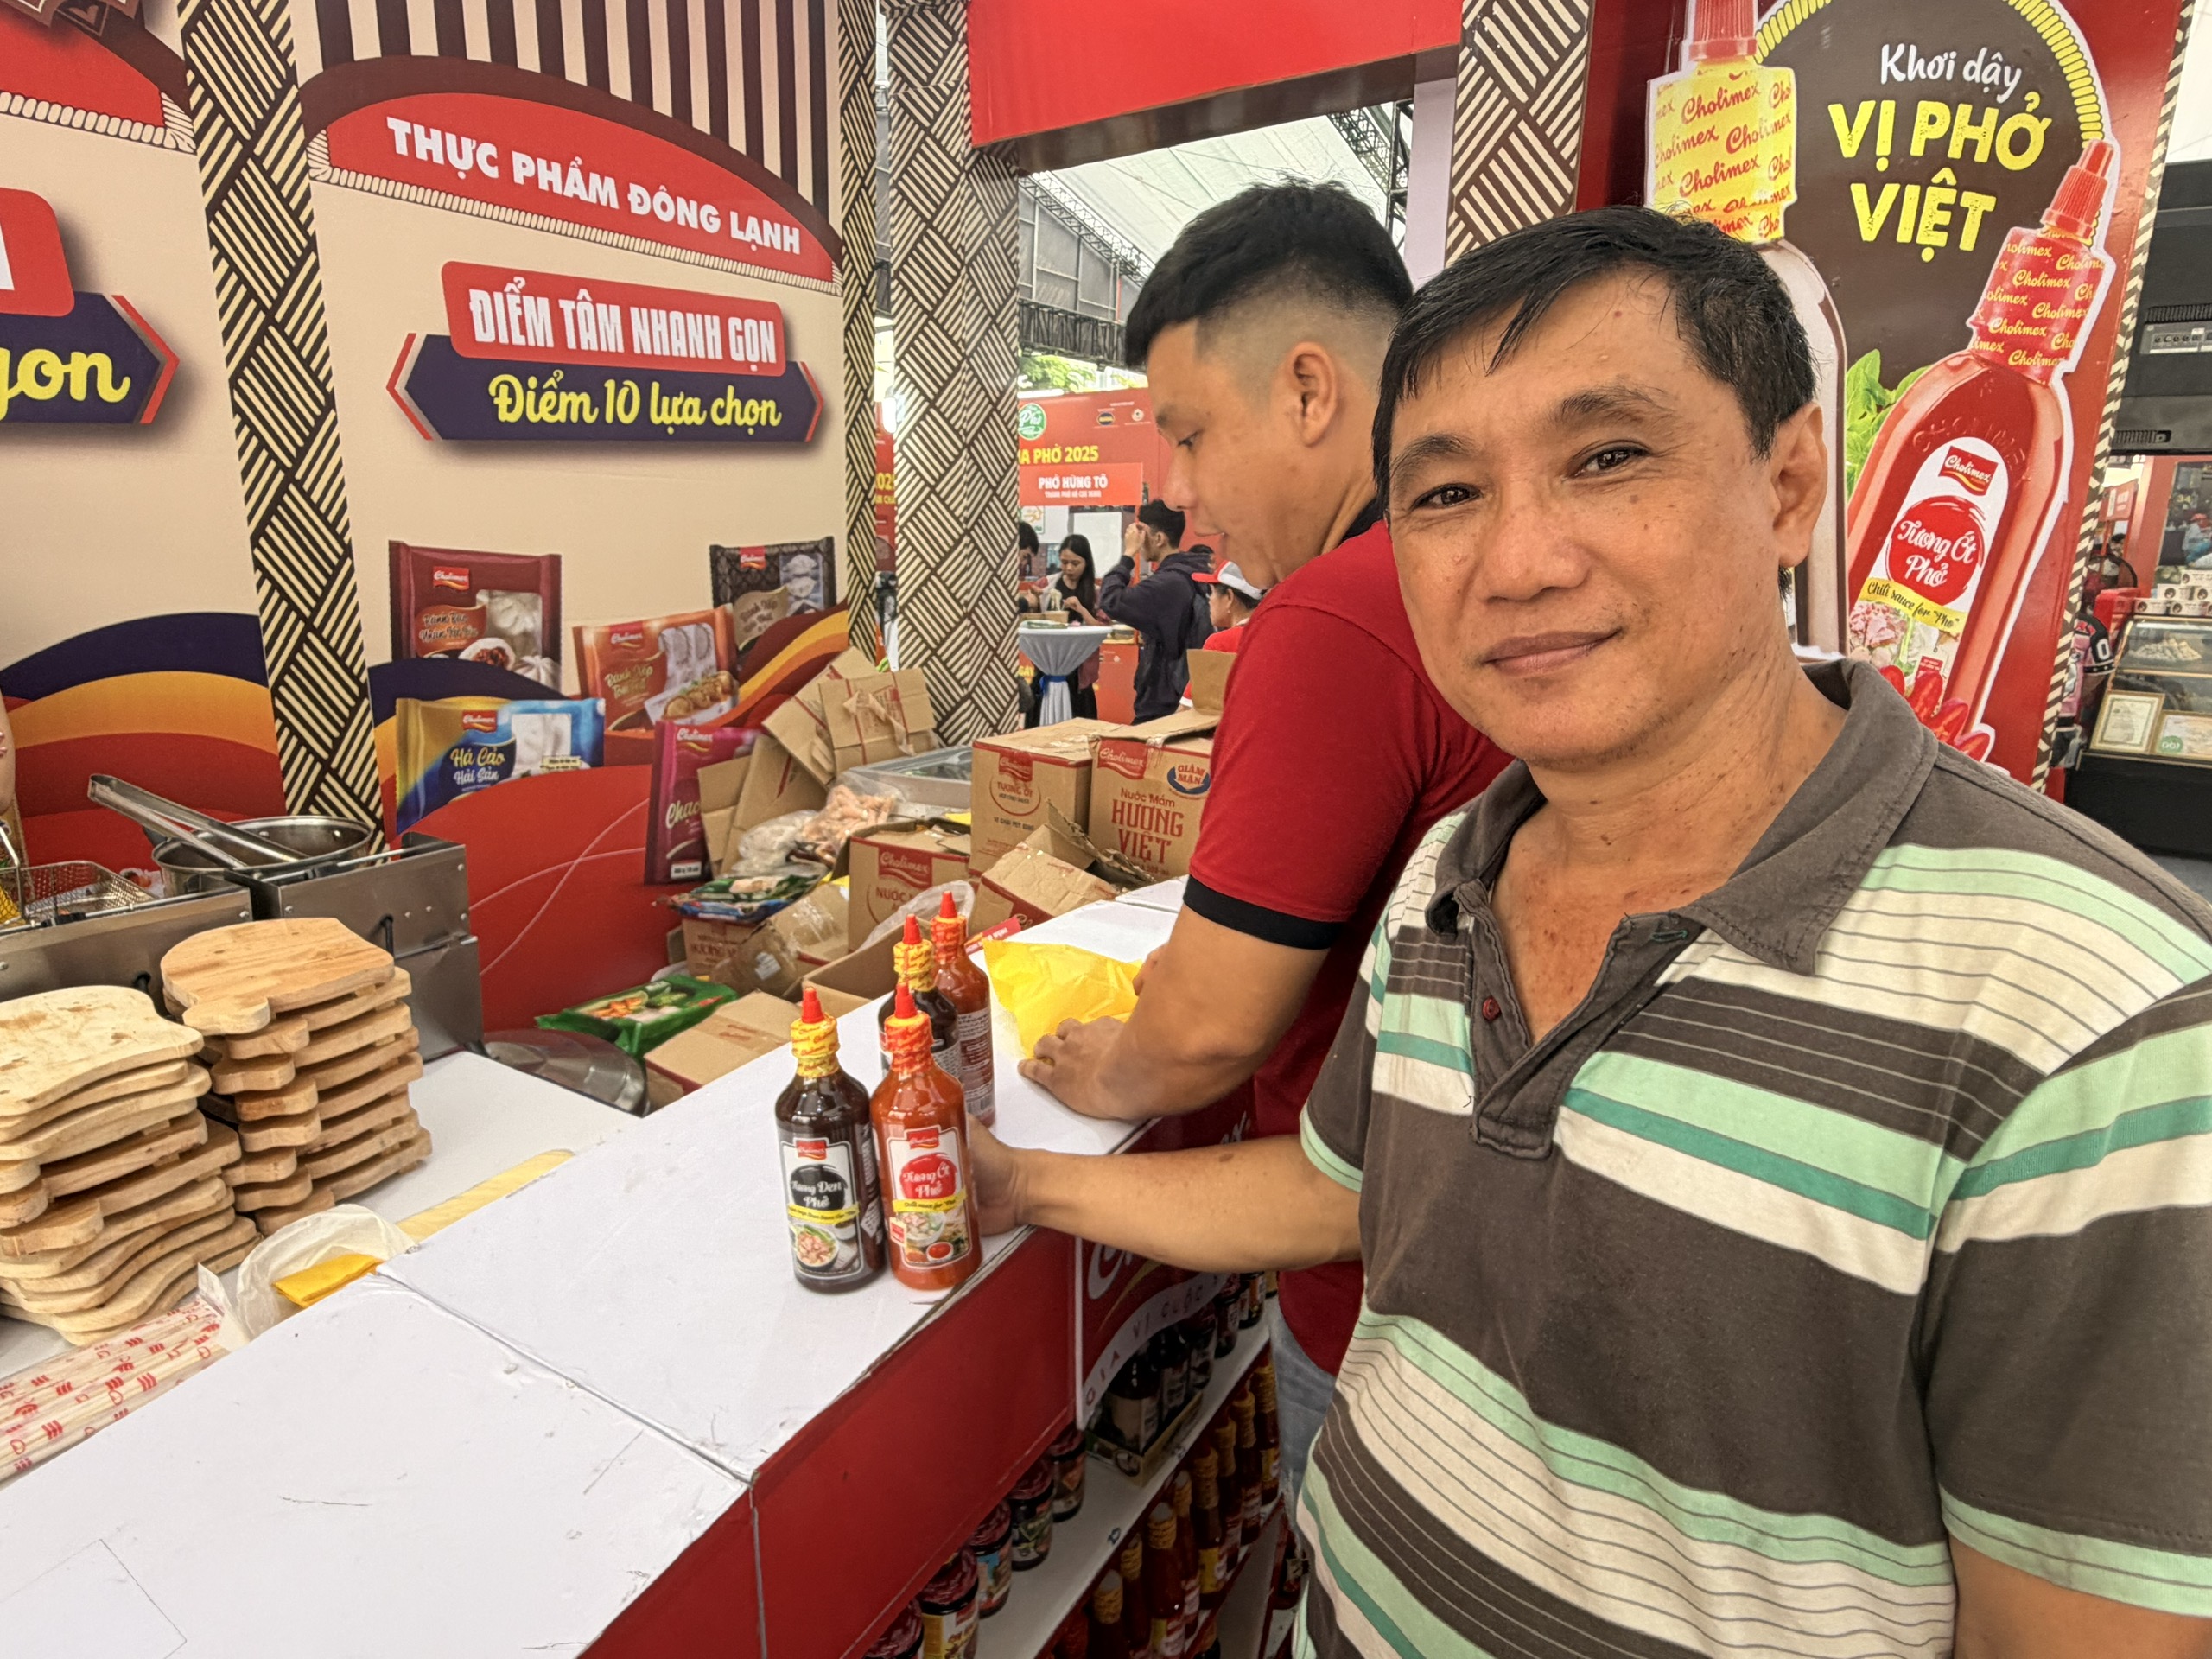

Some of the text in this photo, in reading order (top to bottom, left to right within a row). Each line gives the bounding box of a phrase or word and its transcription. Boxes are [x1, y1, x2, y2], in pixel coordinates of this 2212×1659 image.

[1879, 44, 2022, 103] Khơi dậy
[1681, 82, 1762, 125] Cholimex
[1827, 91, 2053, 171] VỊ PHỞ
[386, 117, 801, 255] THỰC PHẨM ĐÔNG LẠNH
[1679, 153, 1761, 198] Cholimex
[1850, 167, 1997, 263] VIỆT
[2012, 269, 2073, 289] Cholimex
[469, 276, 777, 372] ĐIỂM TÂM NHANH GỌN
[1988, 316, 2048, 338] Cholimex
[488, 369, 782, 435] Điểm 10 lựa chọn
[1033, 443, 1062, 464] PHỞ
[1065, 445, 1099, 462] 2025
[1944, 454, 1992, 484] Cholimex
[1038, 474, 1061, 489] PHỞ
[1062, 474, 1091, 488] HÙNG
[1897, 520, 1977, 564] Tương Ớt
[1904, 555, 1949, 588] Phở
[1867, 581, 1889, 598] Chili
[1891, 590, 1915, 611] sauce
[1913, 601, 1930, 617] for
[2096, 638, 2111, 660] 0
[450, 746, 505, 767] Há Cảo
[1099, 747, 1145, 766] Cholimex
[454, 766, 499, 785] Hải Sản
[1121, 787, 1147, 802] Nước
[1149, 793, 1175, 808] Mắm
[1111, 798, 1185, 837] HƯƠNG
[1119, 829, 1173, 865] VIỆT
